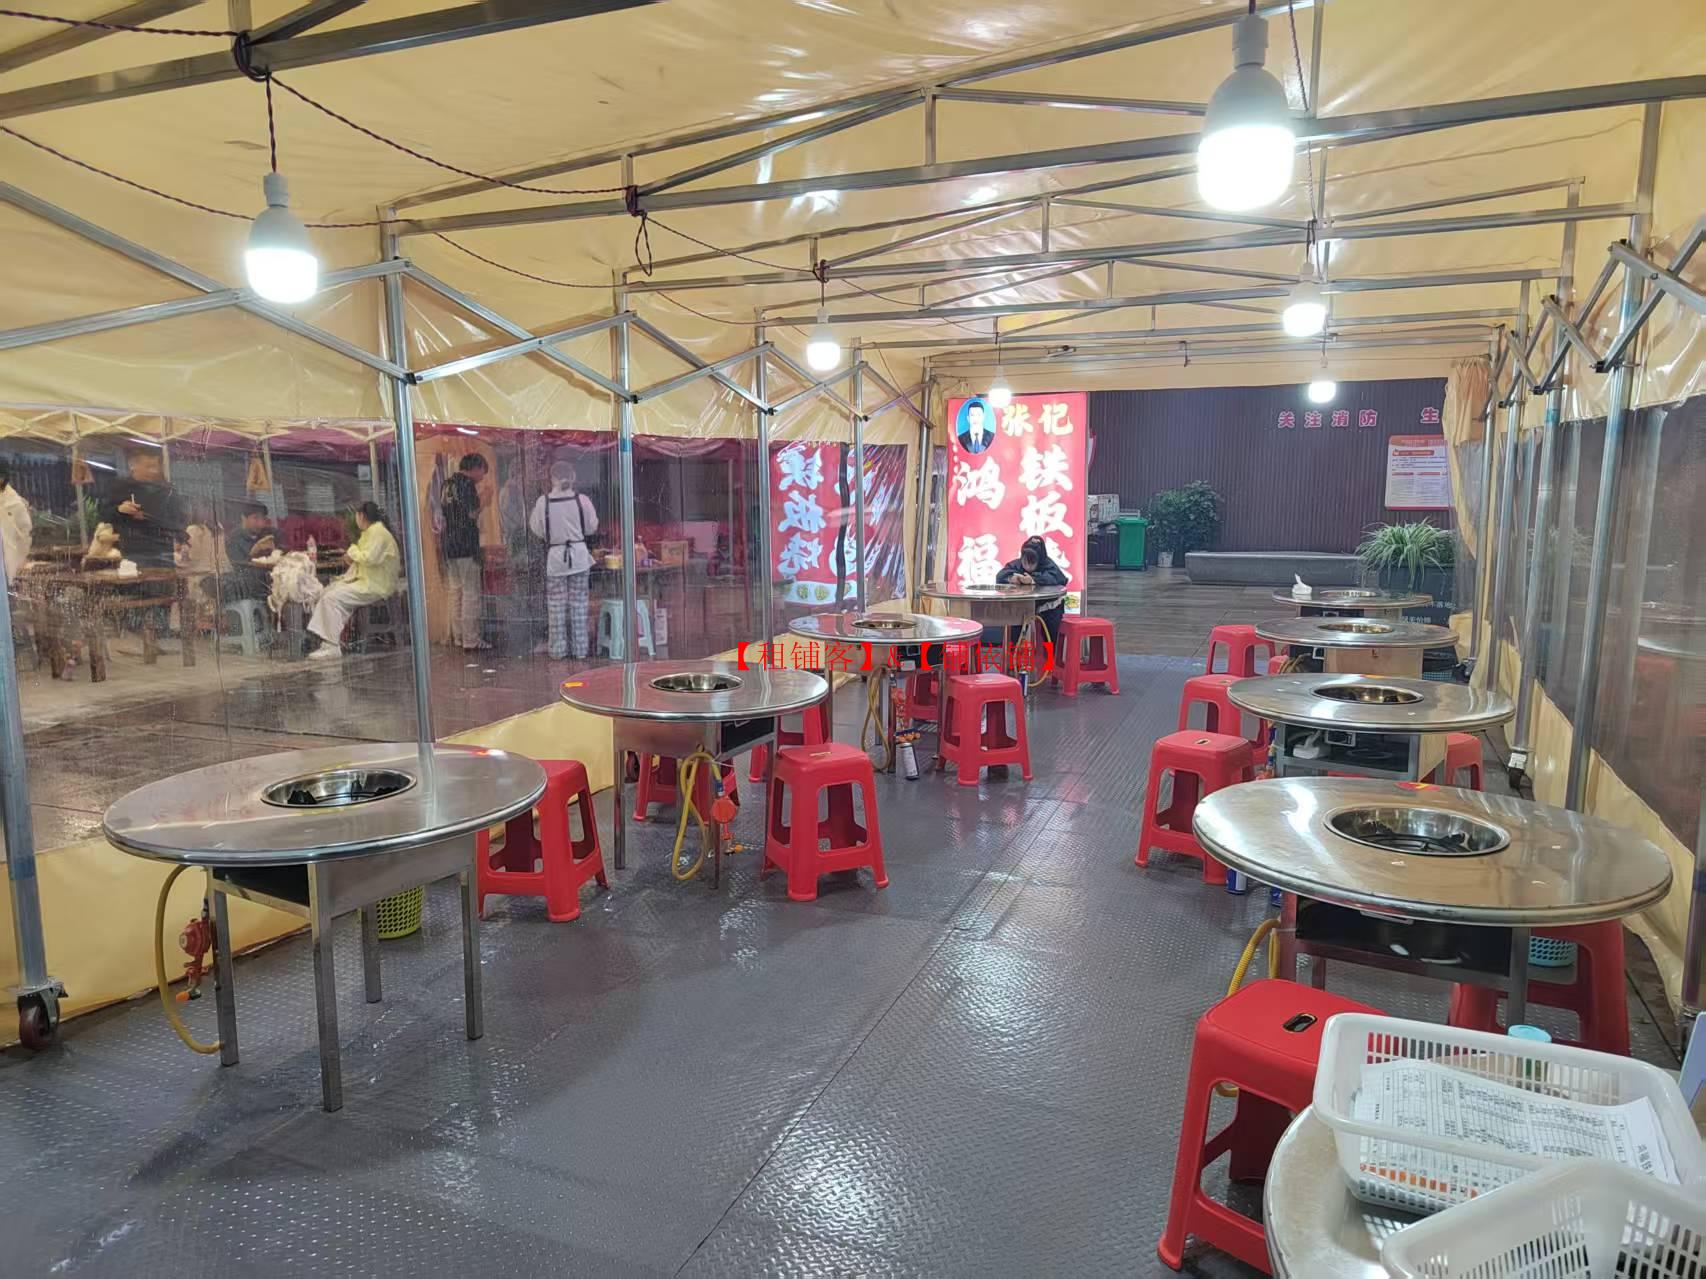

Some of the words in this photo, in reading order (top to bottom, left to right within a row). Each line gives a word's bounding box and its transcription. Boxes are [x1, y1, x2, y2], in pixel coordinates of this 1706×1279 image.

[1001, 403, 1074, 437] 张记
[1278, 410, 1378, 429] 关注消防
